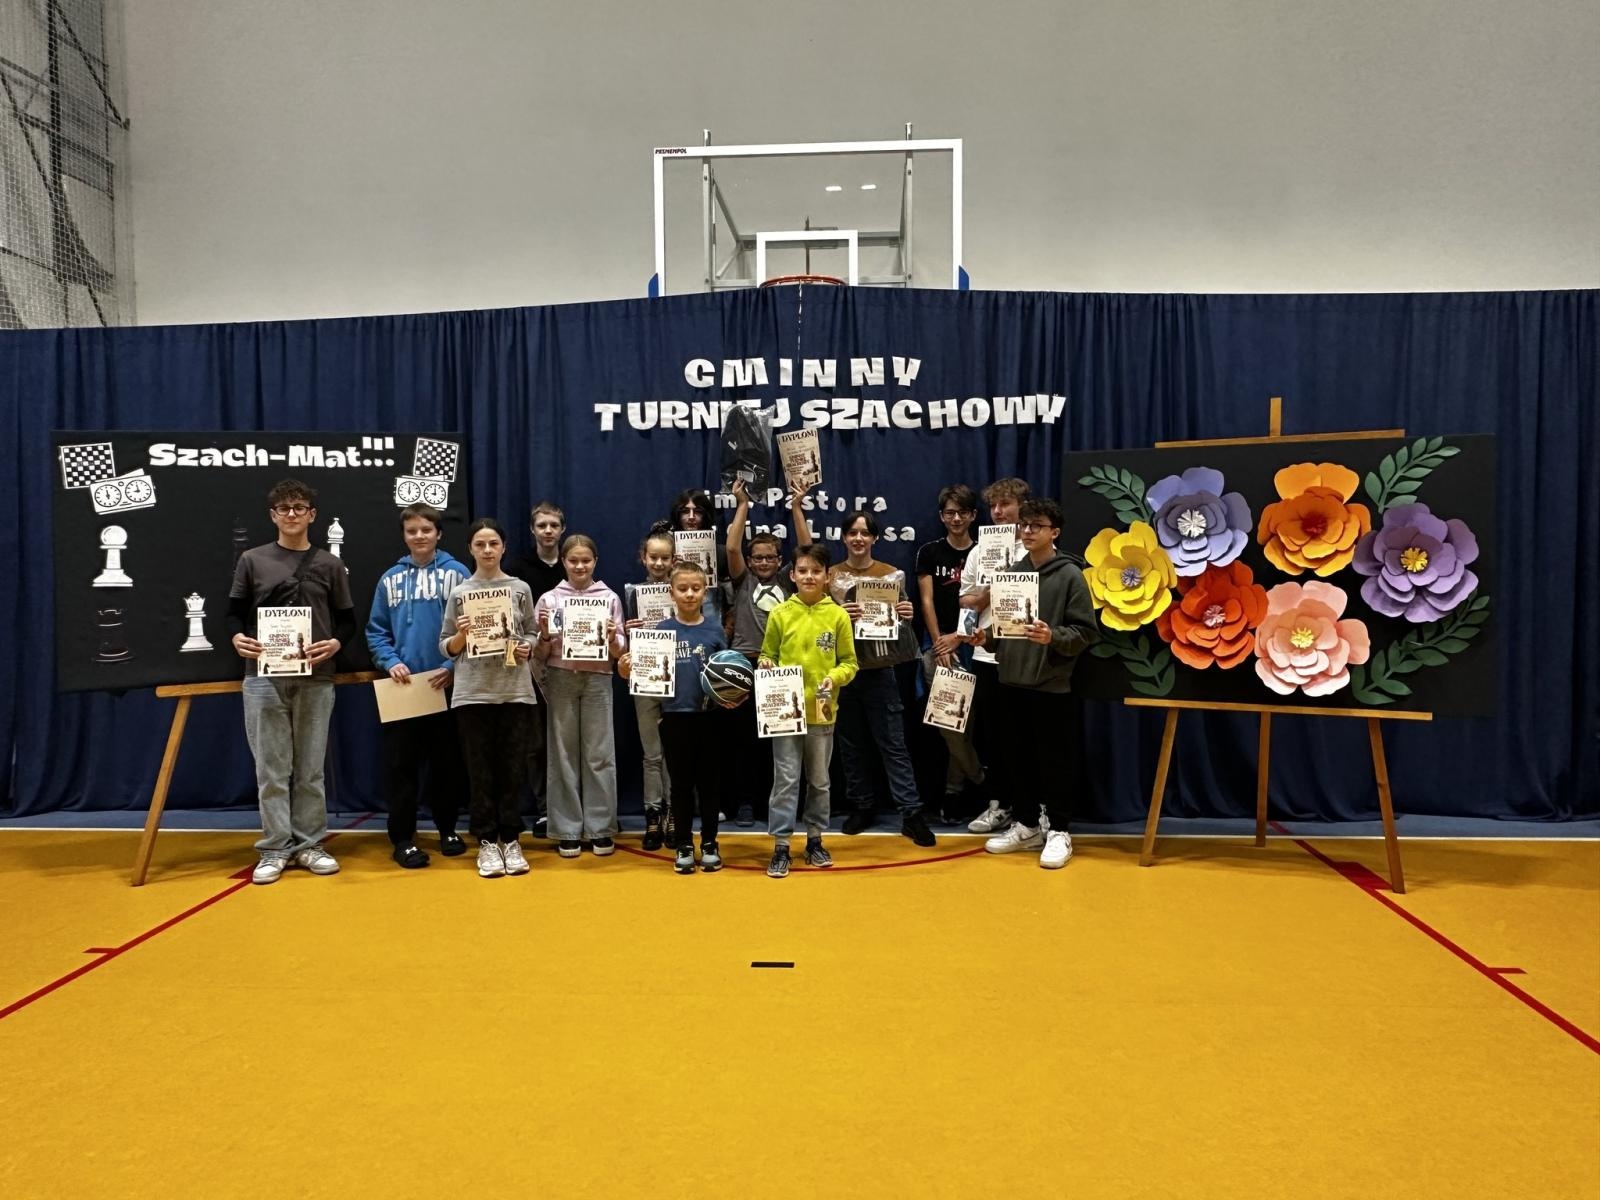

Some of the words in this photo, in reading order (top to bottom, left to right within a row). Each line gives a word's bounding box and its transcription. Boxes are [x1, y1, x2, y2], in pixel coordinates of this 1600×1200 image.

[684, 356, 921, 388] GMINNY
[800, 394, 1067, 430] SZACHOWY
[781, 431, 814, 442] DYPLOM
[983, 527, 1012, 535] DYPLOM
[680, 532, 712, 540] DYPLOM
[996, 575, 1034, 583] DYPLOM
[862, 581, 896, 590] DYPLOM
[468, 589, 507, 601] DYPLOM
[642, 586, 672, 595] DYPLO
[569, 598, 606, 607] DYPLOM
[264, 609, 306, 618] DYPLOM
[635, 631, 672, 640] DYPLOM
[761, 667, 798, 679] DYPLOM
[940, 669, 974, 683] DYPLOM
